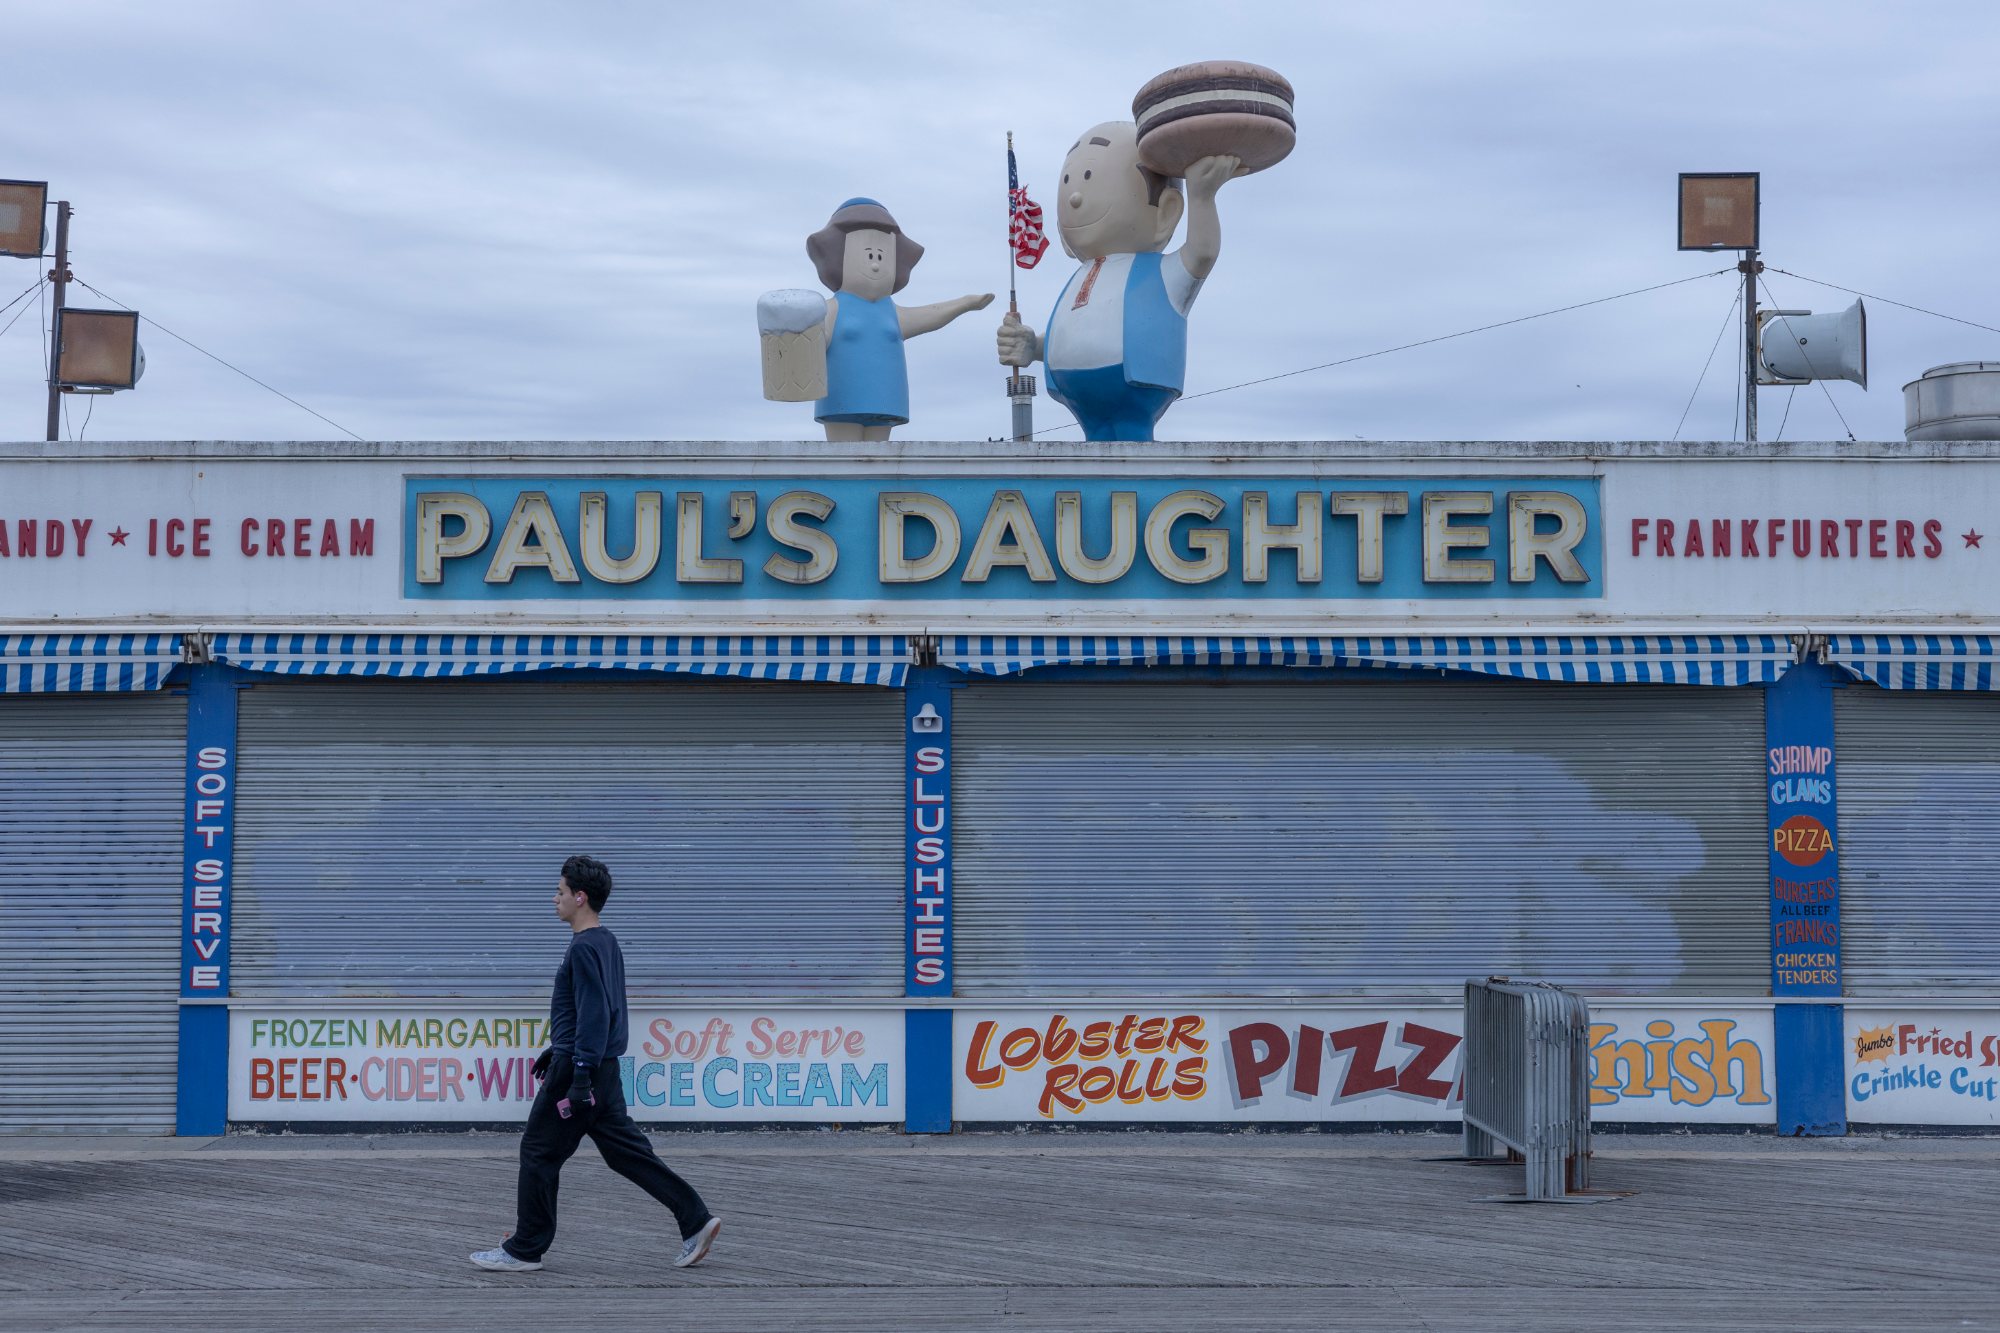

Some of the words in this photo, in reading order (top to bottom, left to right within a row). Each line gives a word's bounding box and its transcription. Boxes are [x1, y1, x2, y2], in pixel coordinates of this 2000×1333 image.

[148, 518, 211, 557] ICE
[240, 518, 375, 557] CREAM
[416, 490, 839, 586] PAUL'S
[878, 489, 1590, 585] DAUGHTER
[1631, 518, 1943, 559] FRANKFURTERS
[1769, 745, 1832, 775] SHRIMP
[194, 747, 227, 848] SOFT
[1771, 778, 1832, 805] CLAMS
[1773, 828, 1835, 852] PIZZA
[913, 747, 945, 986] SLUSHIES
[1774, 876, 1836, 904] BURGERS
[190, 859, 224, 989] SERVE
[1781, 905, 1802, 916] ALL
[1804, 905, 1831, 916] BEEF
[1774, 919, 1838, 949] FRANKS
[1776, 953, 1836, 968] CHICKEN
[1777, 969, 1838, 985] TENDERS
[251, 1018, 367, 1048] FROZEN
[642, 1016, 735, 1062] Soft
[745, 1016, 866, 1058] Serve
[1857, 1033, 1894, 1059] Jumbo
[1898, 1024, 1973, 1060] Fried
[1979, 1035, 2000, 1067] S
[619, 1056, 696, 1107] ICE
[702, 1056, 889, 1108] CREAM
[1223, 1020, 1463, 1109] PIZZ
[1851, 1063, 1942, 1102] Crinkle
[1949, 1066, 1998, 1102] Cut
[1037, 1056, 1209, 1119] ROLLS
